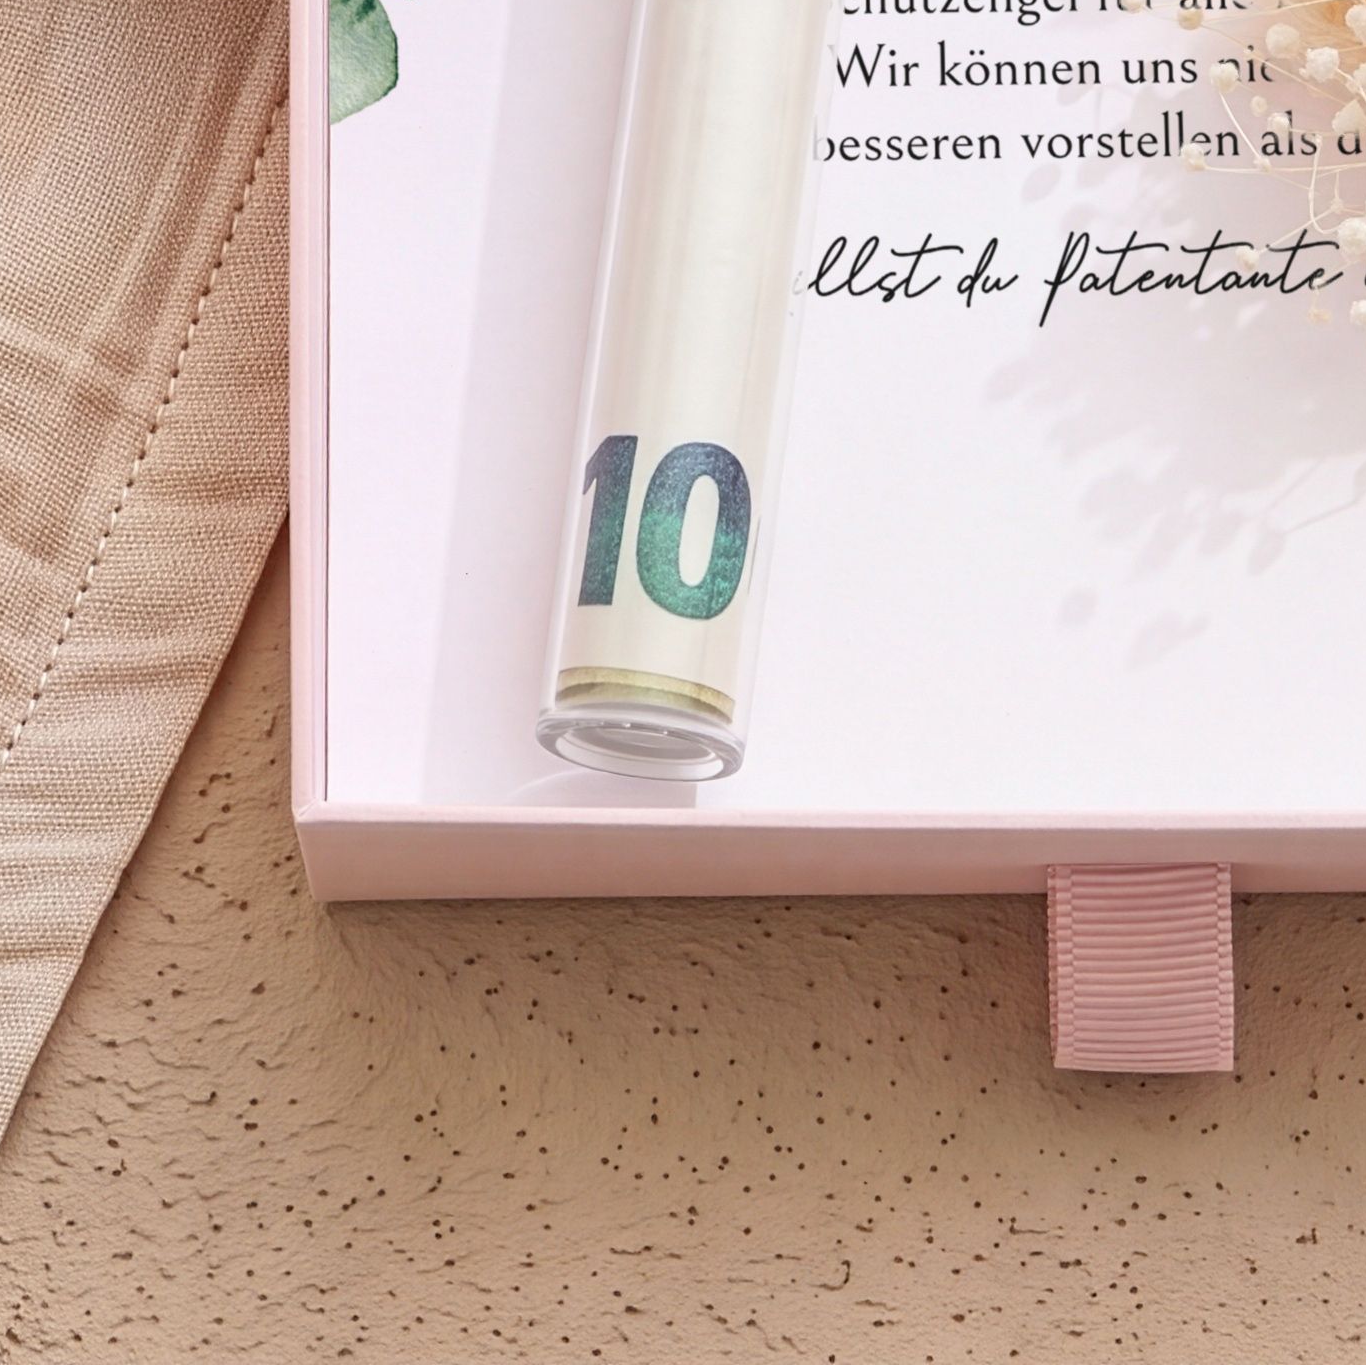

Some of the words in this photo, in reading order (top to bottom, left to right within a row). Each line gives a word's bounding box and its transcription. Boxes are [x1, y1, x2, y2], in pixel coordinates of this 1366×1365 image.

[836, 43, 920, 88] Wir
[937, 40, 1100, 86] können
[1122, 57, 1198, 84] uns
[1021, 110, 1240, 159] vorstellen
[1260, 110, 1319, 157] als
[957, 237, 1019, 308] du
[1039, 228, 1344, 328] Patentante
